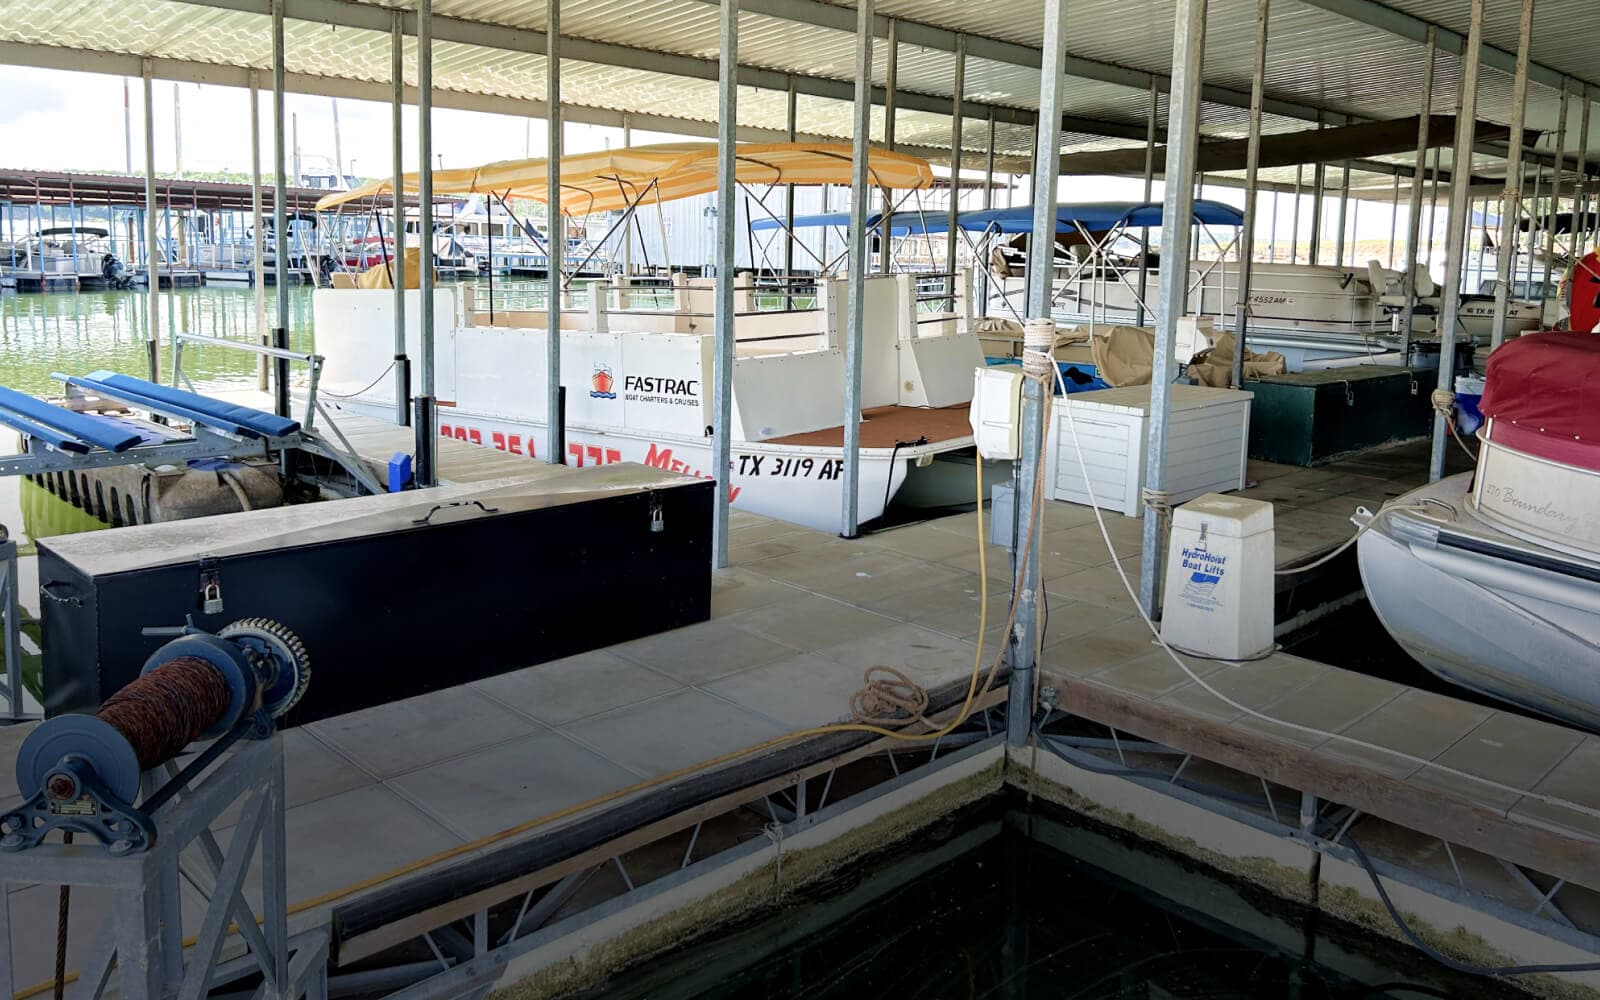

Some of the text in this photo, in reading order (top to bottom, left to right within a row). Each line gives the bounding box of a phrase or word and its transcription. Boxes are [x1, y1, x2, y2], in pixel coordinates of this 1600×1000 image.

[625, 376, 698, 396] FASTRAC
[640, 395, 668, 404] CHARTERS
[675, 398, 699, 407] CRUISES
[739, 456, 765, 476] TX
[771, 458, 814, 477] 3119
[1502, 487, 1580, 534] Boundary
[1182, 548, 1227, 565] HydroHoist
[1182, 559, 1225, 576] Boat Lifts
